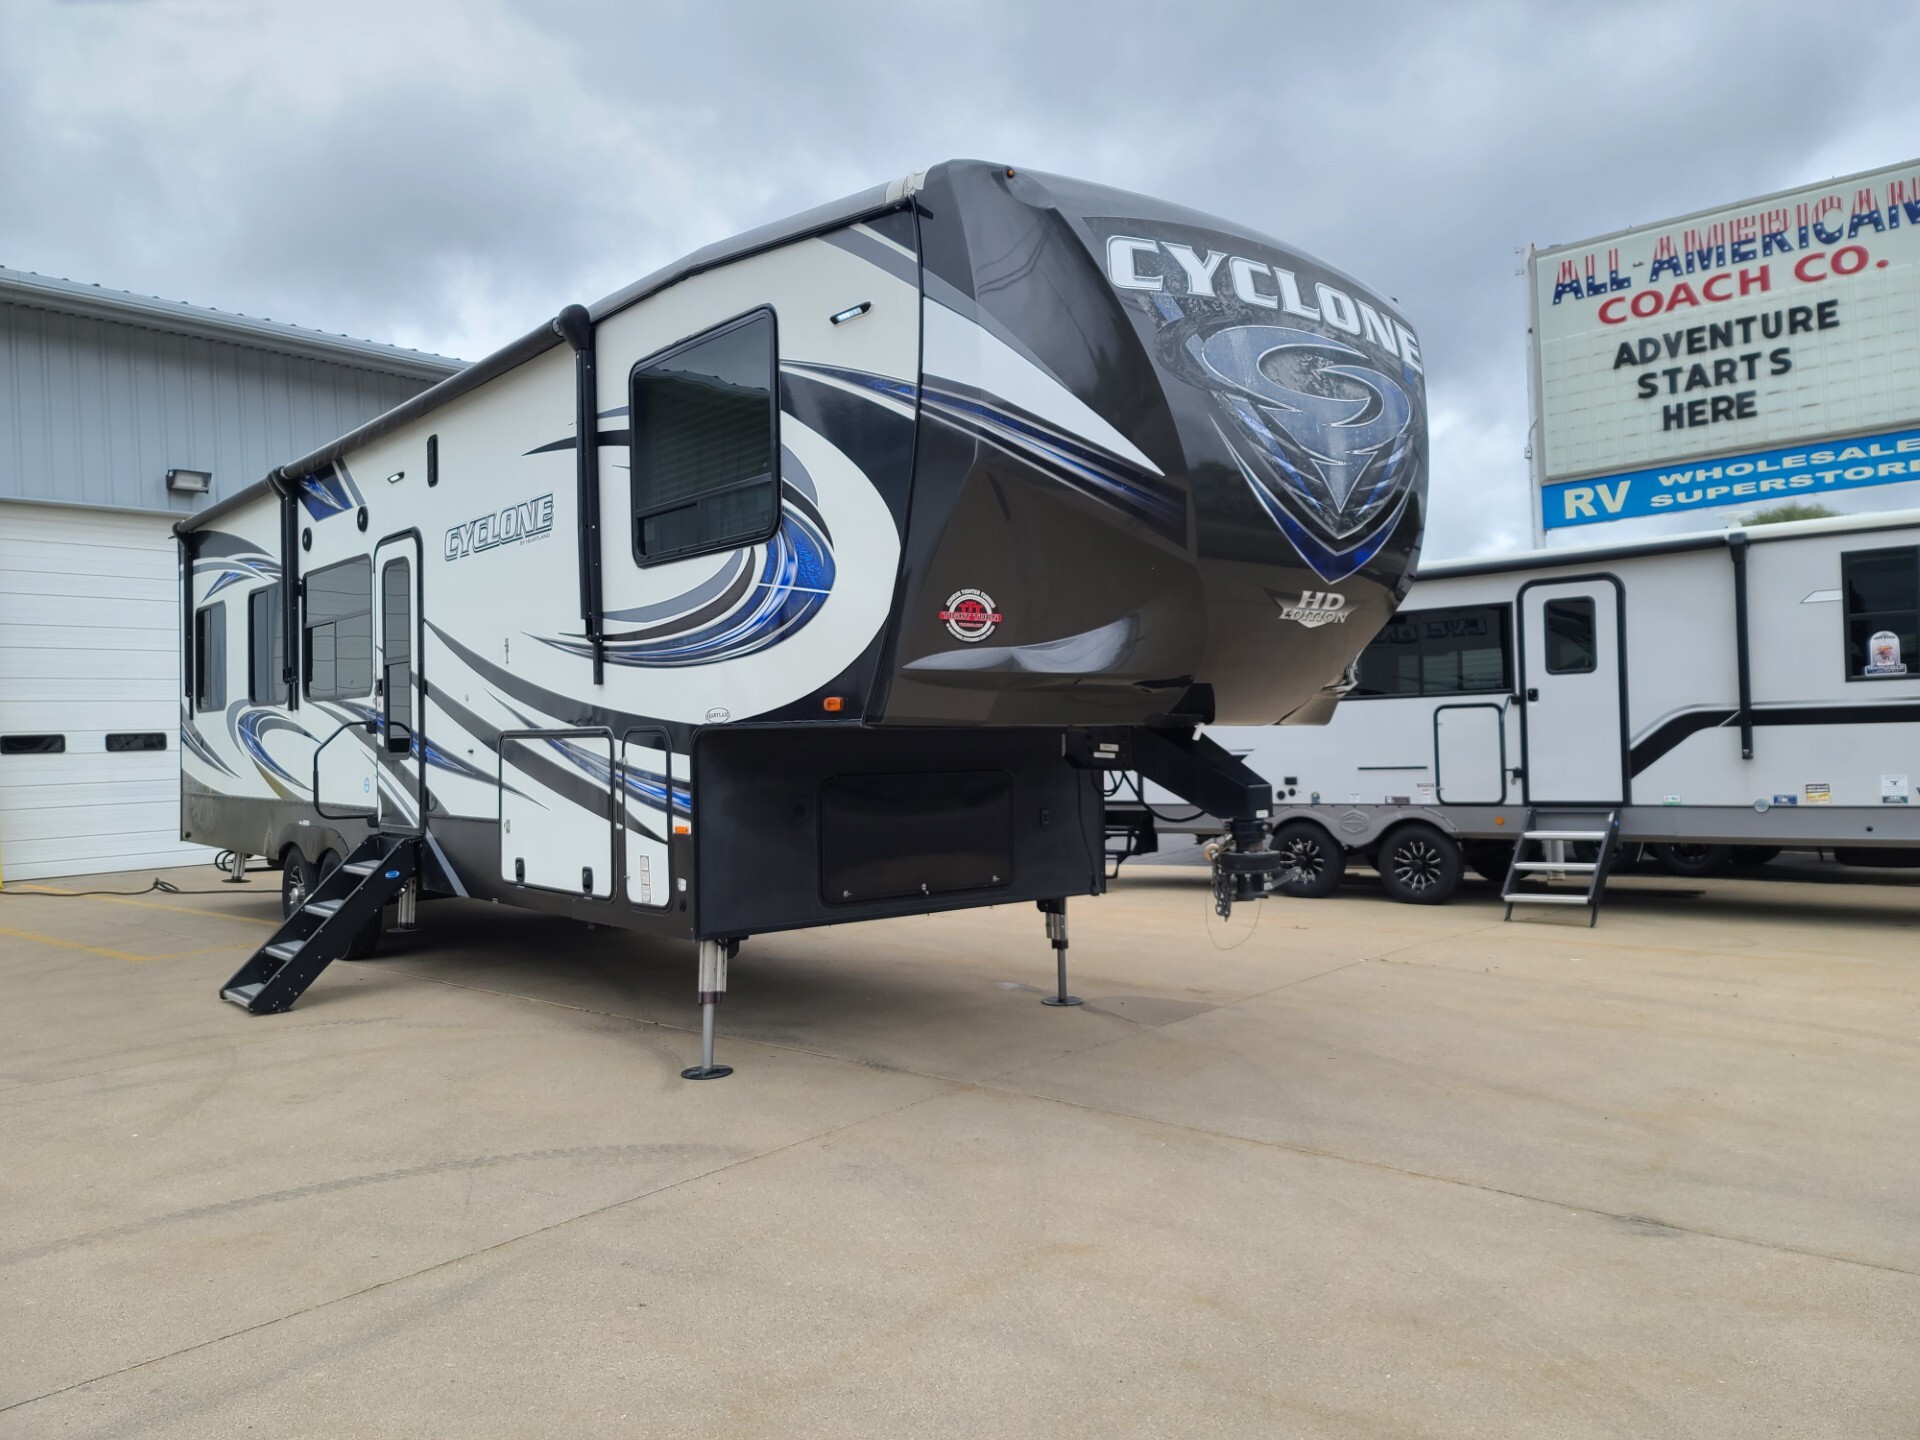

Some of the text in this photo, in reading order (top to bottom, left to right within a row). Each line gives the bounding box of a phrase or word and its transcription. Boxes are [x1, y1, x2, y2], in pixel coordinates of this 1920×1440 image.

[1552, 174, 1920, 305] ALL-AMERICAN
[1106, 235, 1424, 372] CYCLONE
[1598, 245, 1890, 325] COACH CO.
[1612, 299, 1840, 370] ADVENTURE
[1636, 347, 1793, 399] STARTS
[1662, 390, 1758, 431] HERE
[1657, 438, 1920, 487] WHOLESALE
[1563, 480, 1631, 520] RV
[444, 492, 554, 562] CYCLONE
[943, 612, 999, 622] TIGHT TURN
[1278, 607, 1349, 624] EDITION
[1296, 590, 1346, 610] HD
